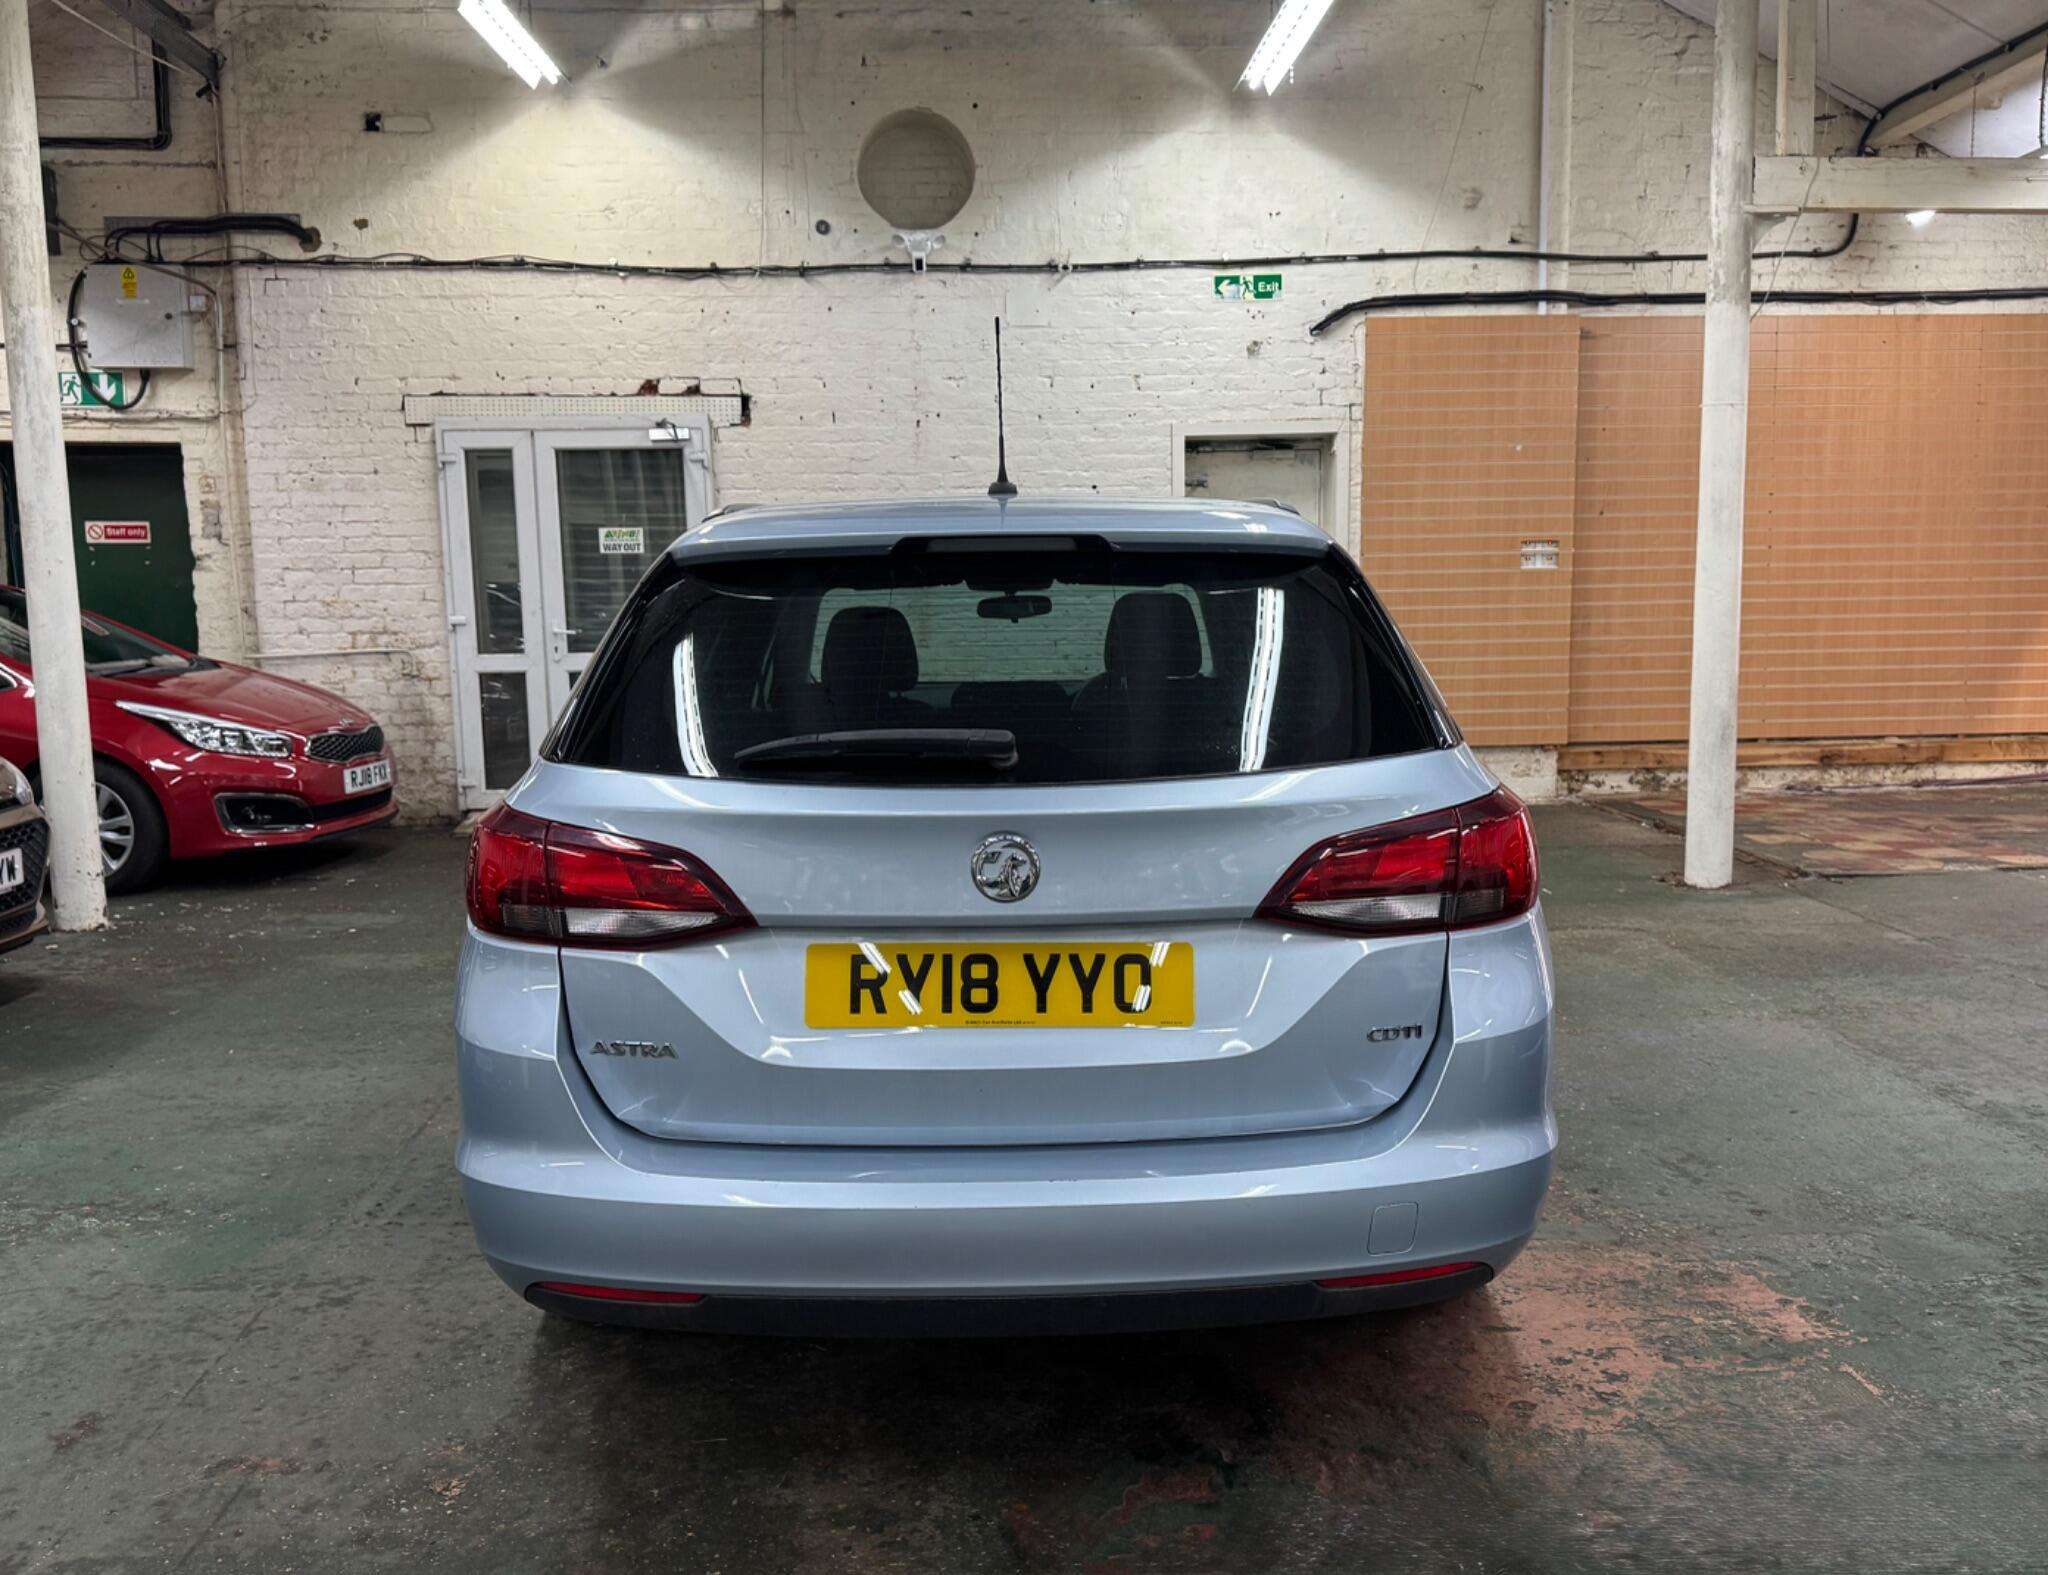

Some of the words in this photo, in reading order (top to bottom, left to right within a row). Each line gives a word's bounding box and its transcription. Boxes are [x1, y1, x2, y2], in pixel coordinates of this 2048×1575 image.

[1258, 281, 1279, 293] Exit
[105, 526, 126, 537] Staff
[127, 527, 146, 539] only
[603, 542, 622, 552] WAY
[623, 542, 641, 551] OUT
[849, 952, 1000, 1015] RY18
[1022, 952, 1152, 1015] YYO
[590, 1040, 679, 1060] ASTRA
